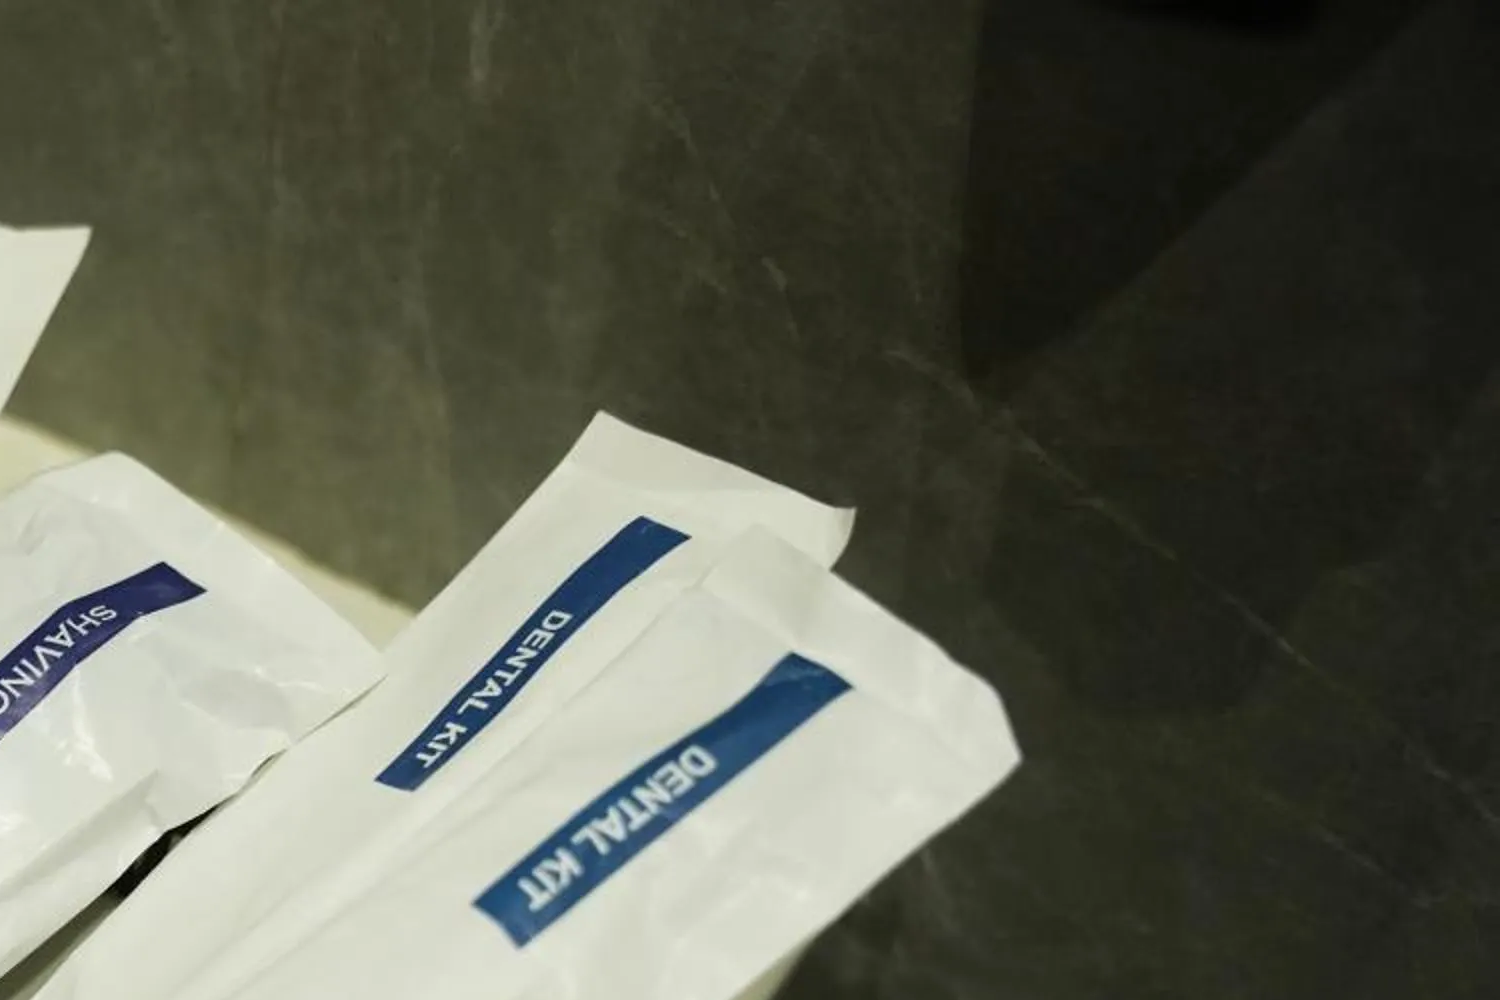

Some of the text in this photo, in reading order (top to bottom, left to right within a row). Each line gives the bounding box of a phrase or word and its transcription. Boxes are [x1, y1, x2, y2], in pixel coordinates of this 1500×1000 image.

[415, 609, 573, 768] DENTAL KIT
[517, 744, 718, 911] DENTAL KIT
